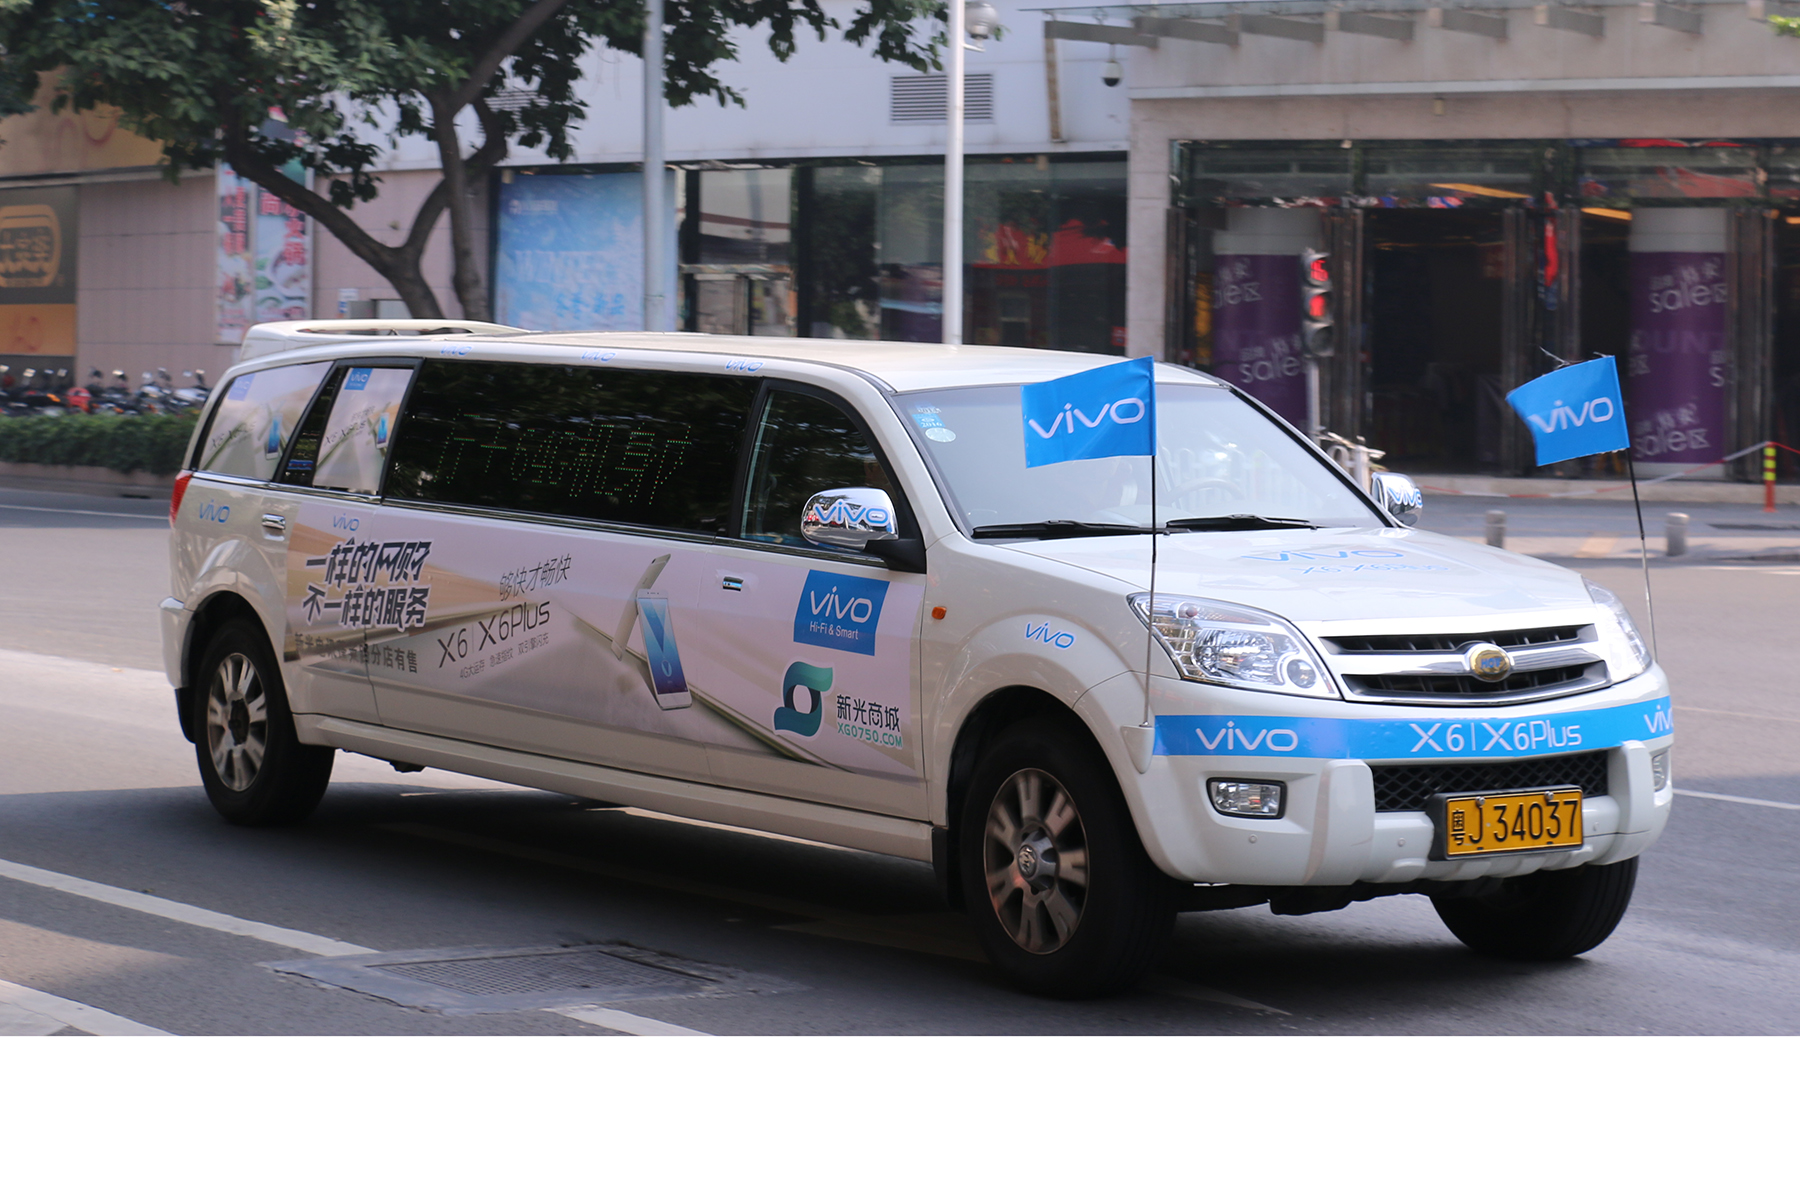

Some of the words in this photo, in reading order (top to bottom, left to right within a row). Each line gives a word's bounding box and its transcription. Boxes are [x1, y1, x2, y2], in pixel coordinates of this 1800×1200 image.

[439, 345, 473, 356] vivo
[580, 351, 616, 362] vivo
[725, 358, 766, 373] vivo
[1028, 397, 1145, 439] vivo
[1526, 396, 1614, 434] vivo
[1387, 485, 1423, 506] vivo
[199, 499, 231, 523] vivo
[333, 512, 360, 531] vivo
[814, 500, 889, 525] vivo
[305, 536, 433, 589] 一样的网购
[1240, 549, 1404, 562] vivo
[499, 553, 571, 601] 够快才畅快
[302, 583, 430, 629] 不一样的服务
[810, 586, 873, 624] vivo
[810, 620, 828, 635] Hi-Fi
[828, 624, 835, 635] &
[835, 625, 859, 640] Smart
[1026, 622, 1075, 649] vivo
[836, 694, 901, 733] 新光商城
[1643, 704, 1673, 734] viv
[837, 721, 903, 748] XG0750.COM
[1195, 720, 1298, 752] vivo
[1409, 722, 1465, 752] X6
